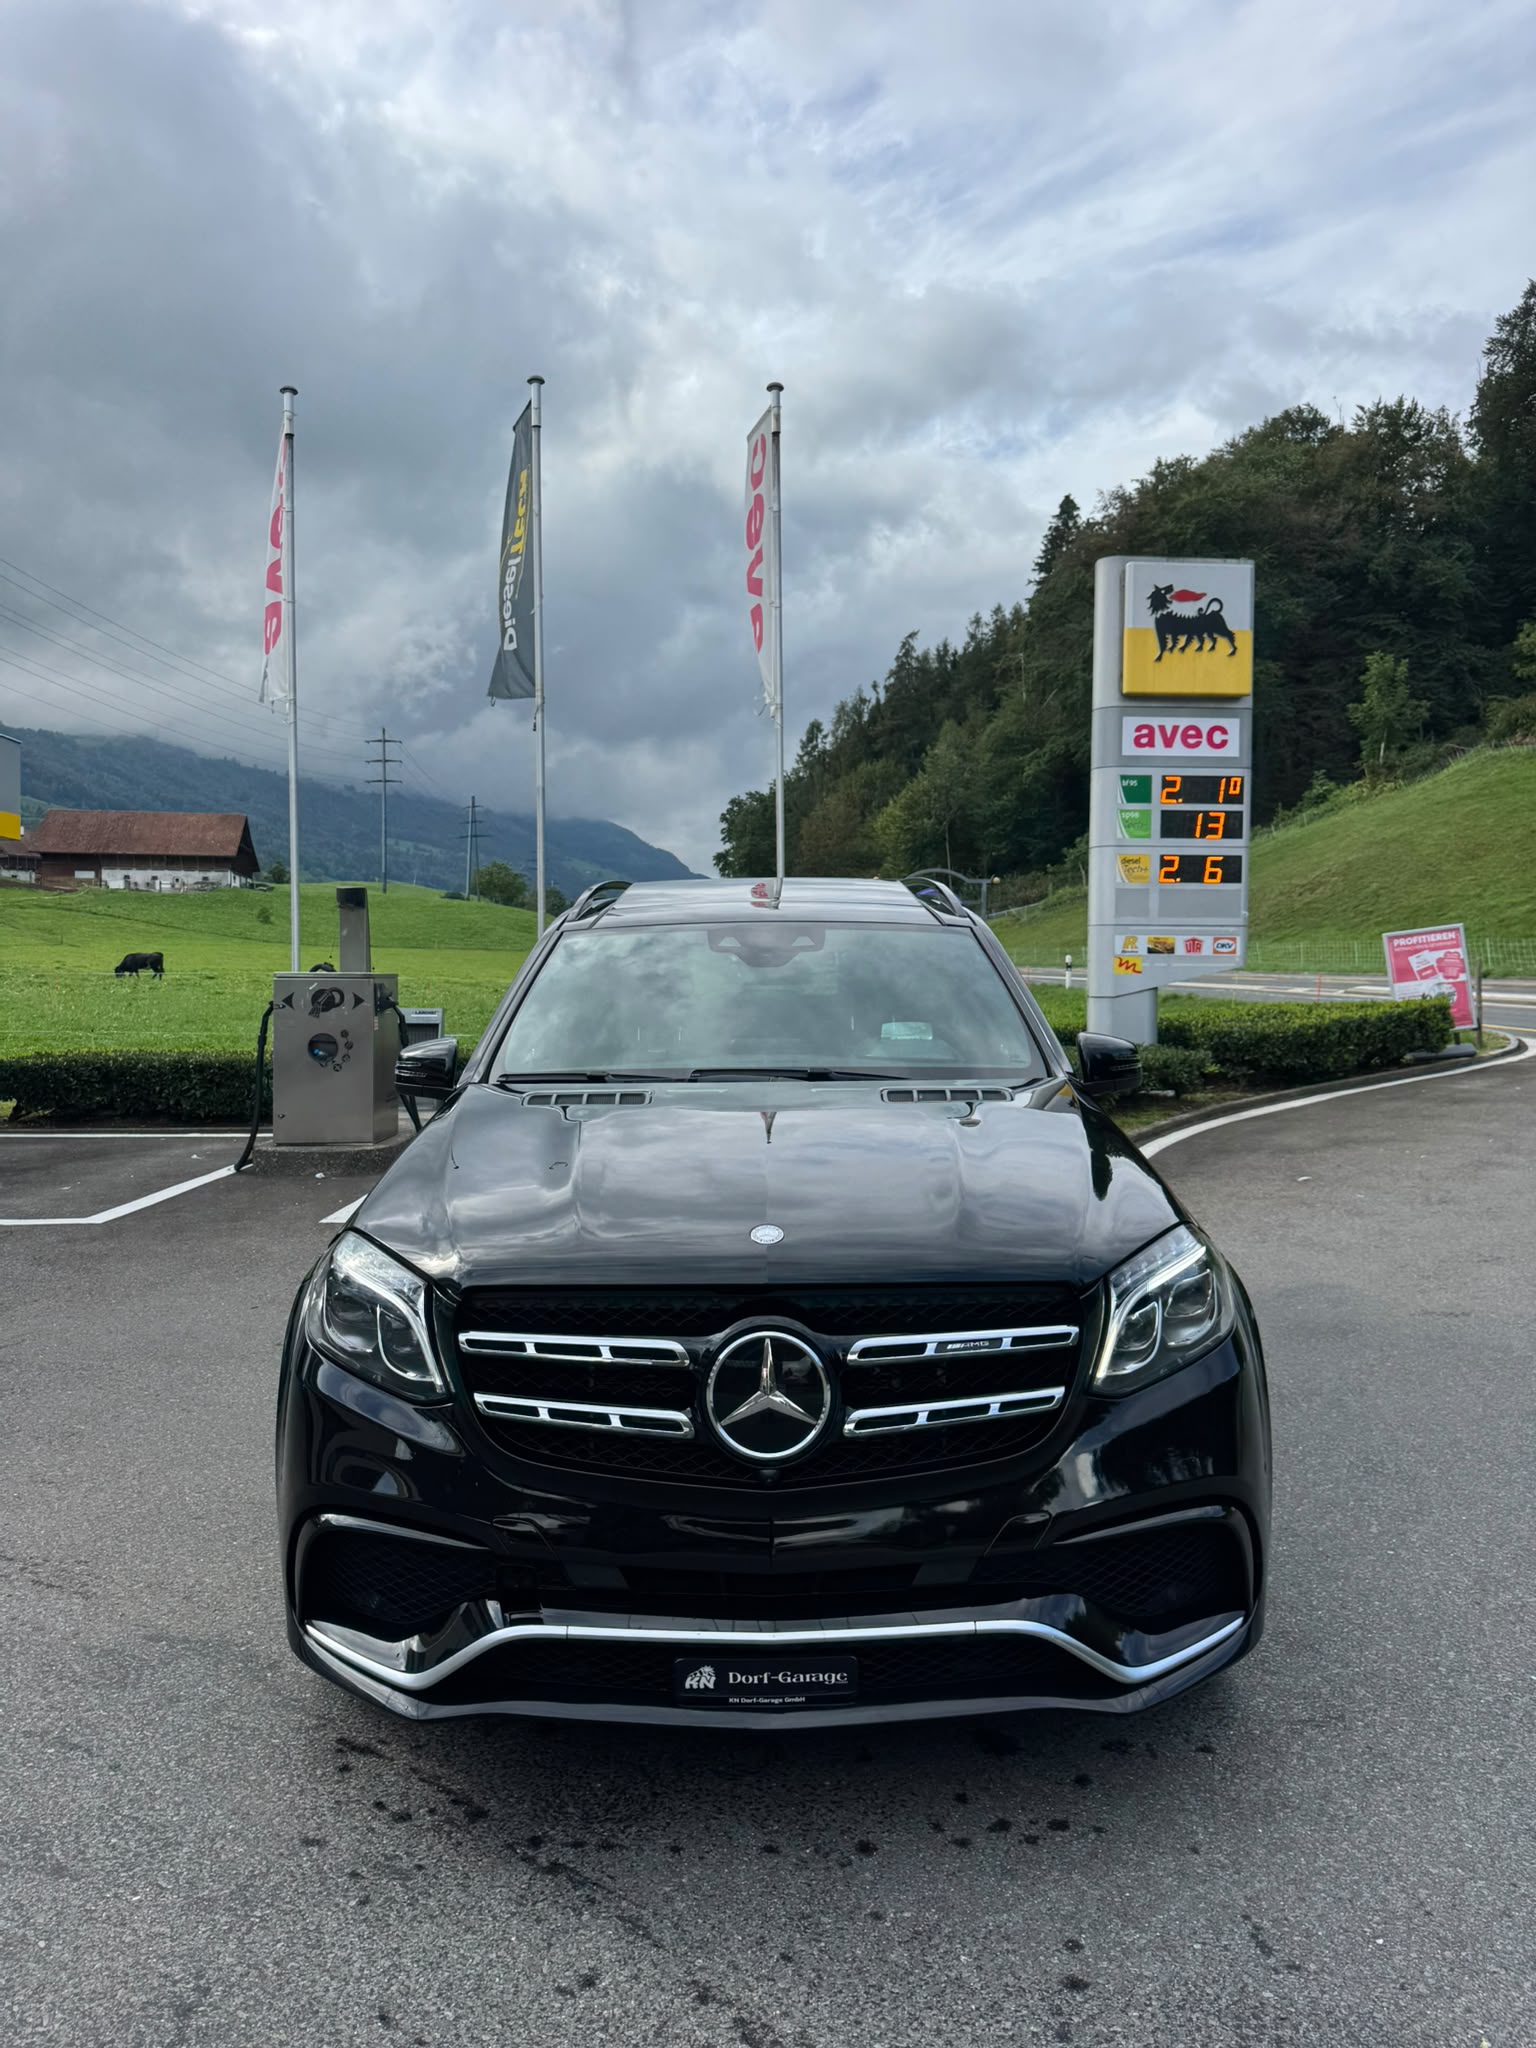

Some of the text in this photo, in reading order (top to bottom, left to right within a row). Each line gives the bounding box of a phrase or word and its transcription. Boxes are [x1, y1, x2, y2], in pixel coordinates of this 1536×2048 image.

[1133, 724, 1229, 749] avec
[1194, 812, 1226, 840] 13
[1203, 856, 1225, 884] 6
[1184, 938, 1204, 954] UTA
[1393, 931, 1456, 947] PROFITIEREN
[728, 1671, 849, 1685] Dorf-Garage
